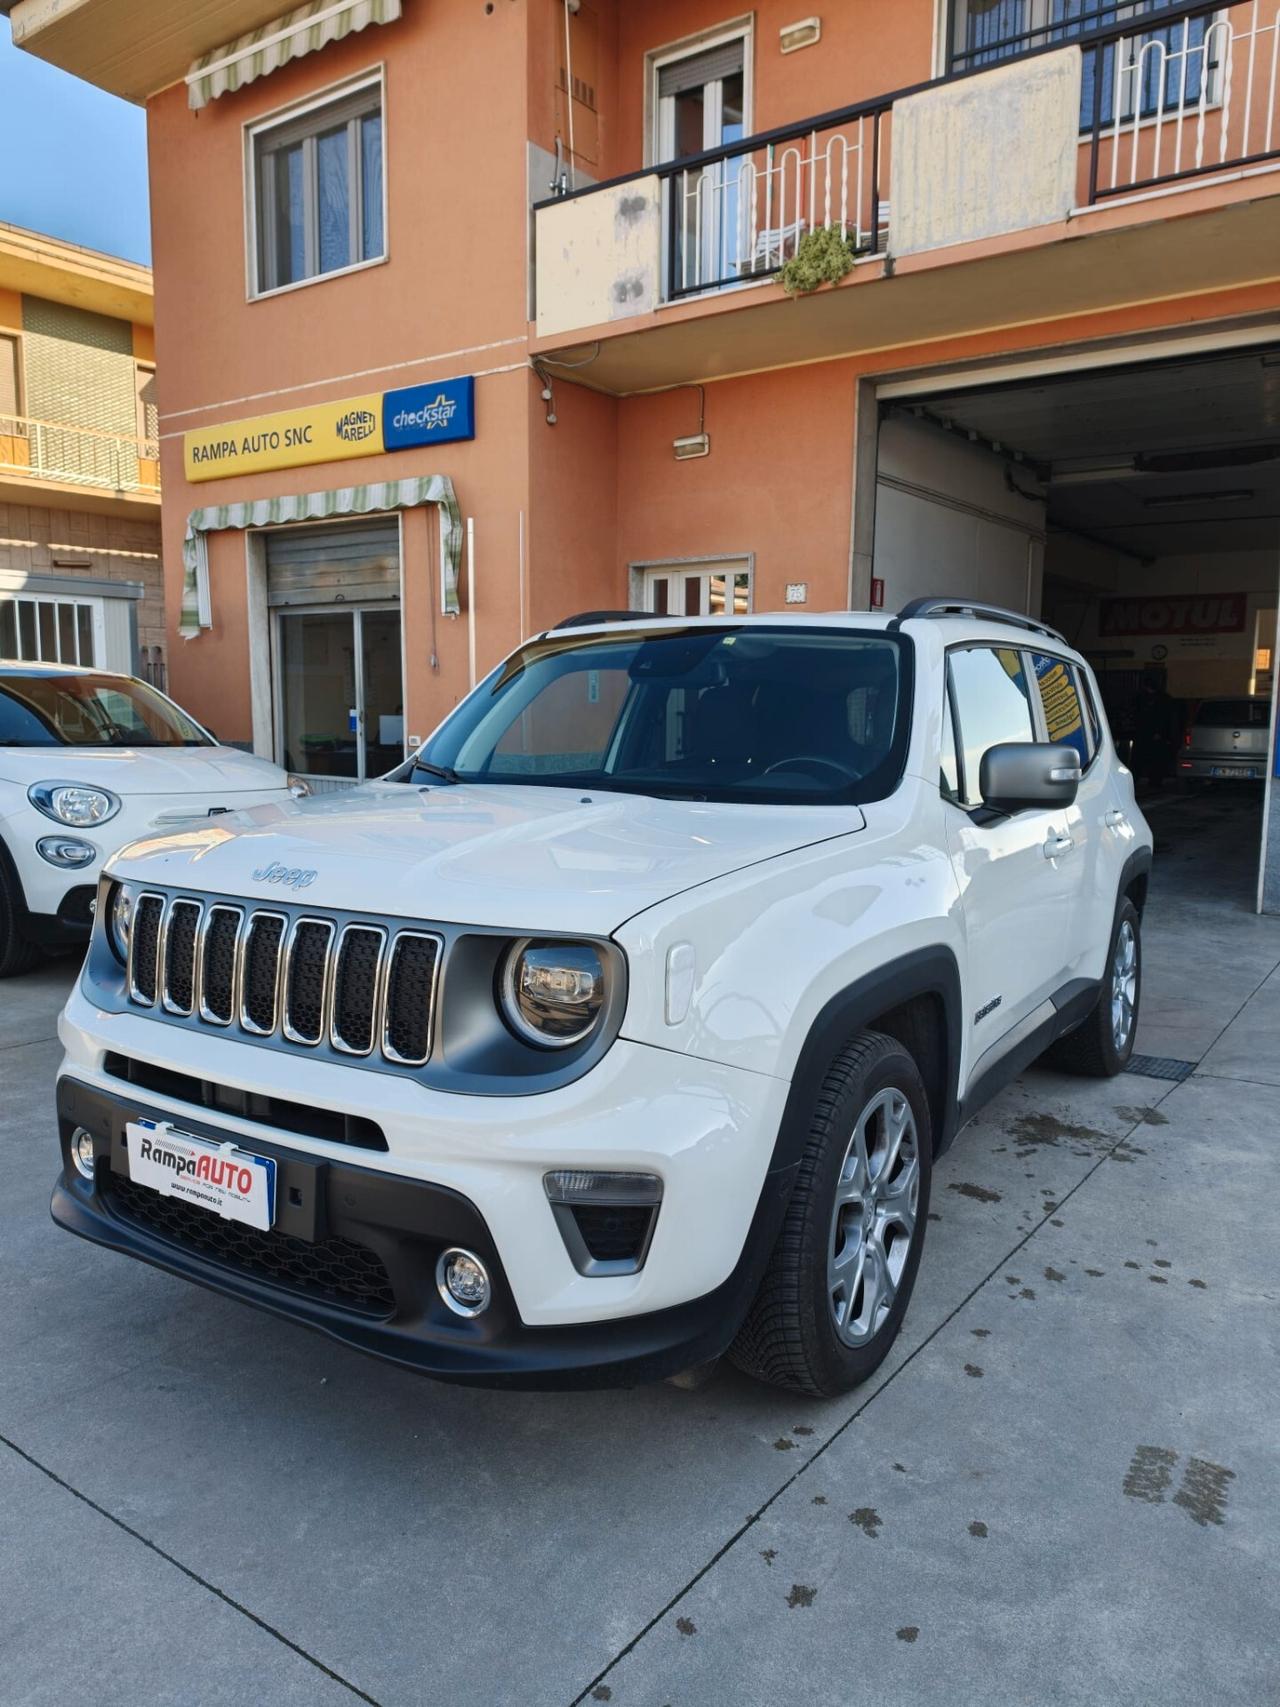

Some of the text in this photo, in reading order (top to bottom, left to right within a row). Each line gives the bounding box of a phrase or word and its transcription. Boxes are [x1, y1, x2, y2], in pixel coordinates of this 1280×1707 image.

[393, 405, 456, 428] checkstar
[192, 425, 313, 463] RAMPA AUTO SNC
[1104, 599, 1238, 631] MOTUL
[252, 861, 318, 891] Jeep
